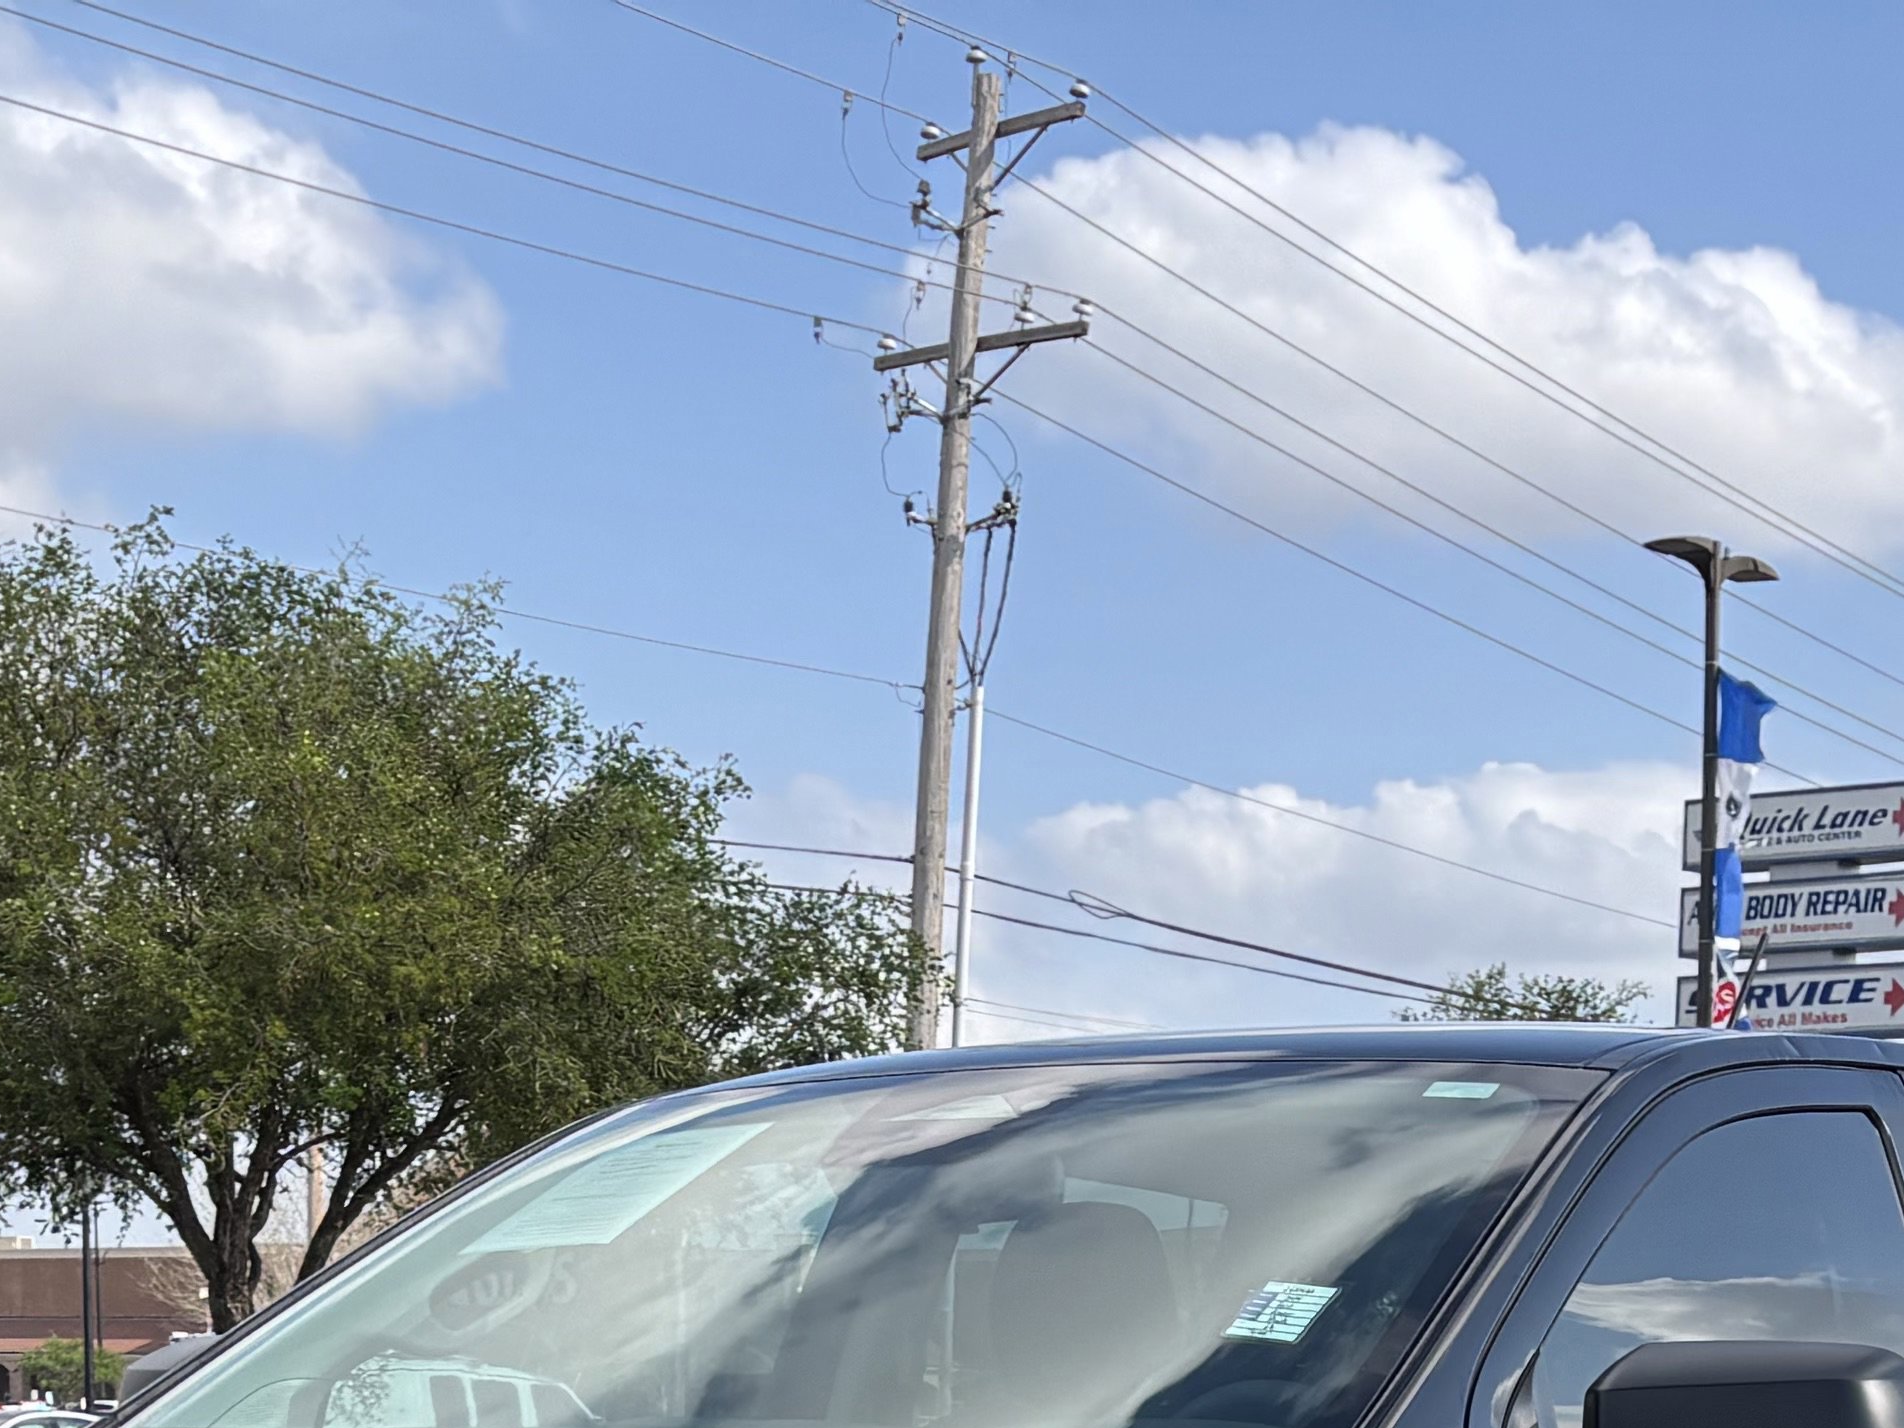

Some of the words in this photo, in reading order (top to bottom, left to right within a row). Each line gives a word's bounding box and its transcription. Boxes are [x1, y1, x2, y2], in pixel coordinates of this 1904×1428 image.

[1739, 805, 1809, 840] uick
[1812, 804, 1889, 831] Lane
[1785, 833, 1816, 844] AUTO
[1817, 830, 1863, 842] CENTER
[1745, 892, 1804, 921] BODY
[1805, 887, 1888, 917] REPAIR
[1790, 920, 1854, 934] Insurance
[1777, 1013, 1797, 1028] All
[1800, 1011, 1849, 1026] Makes
